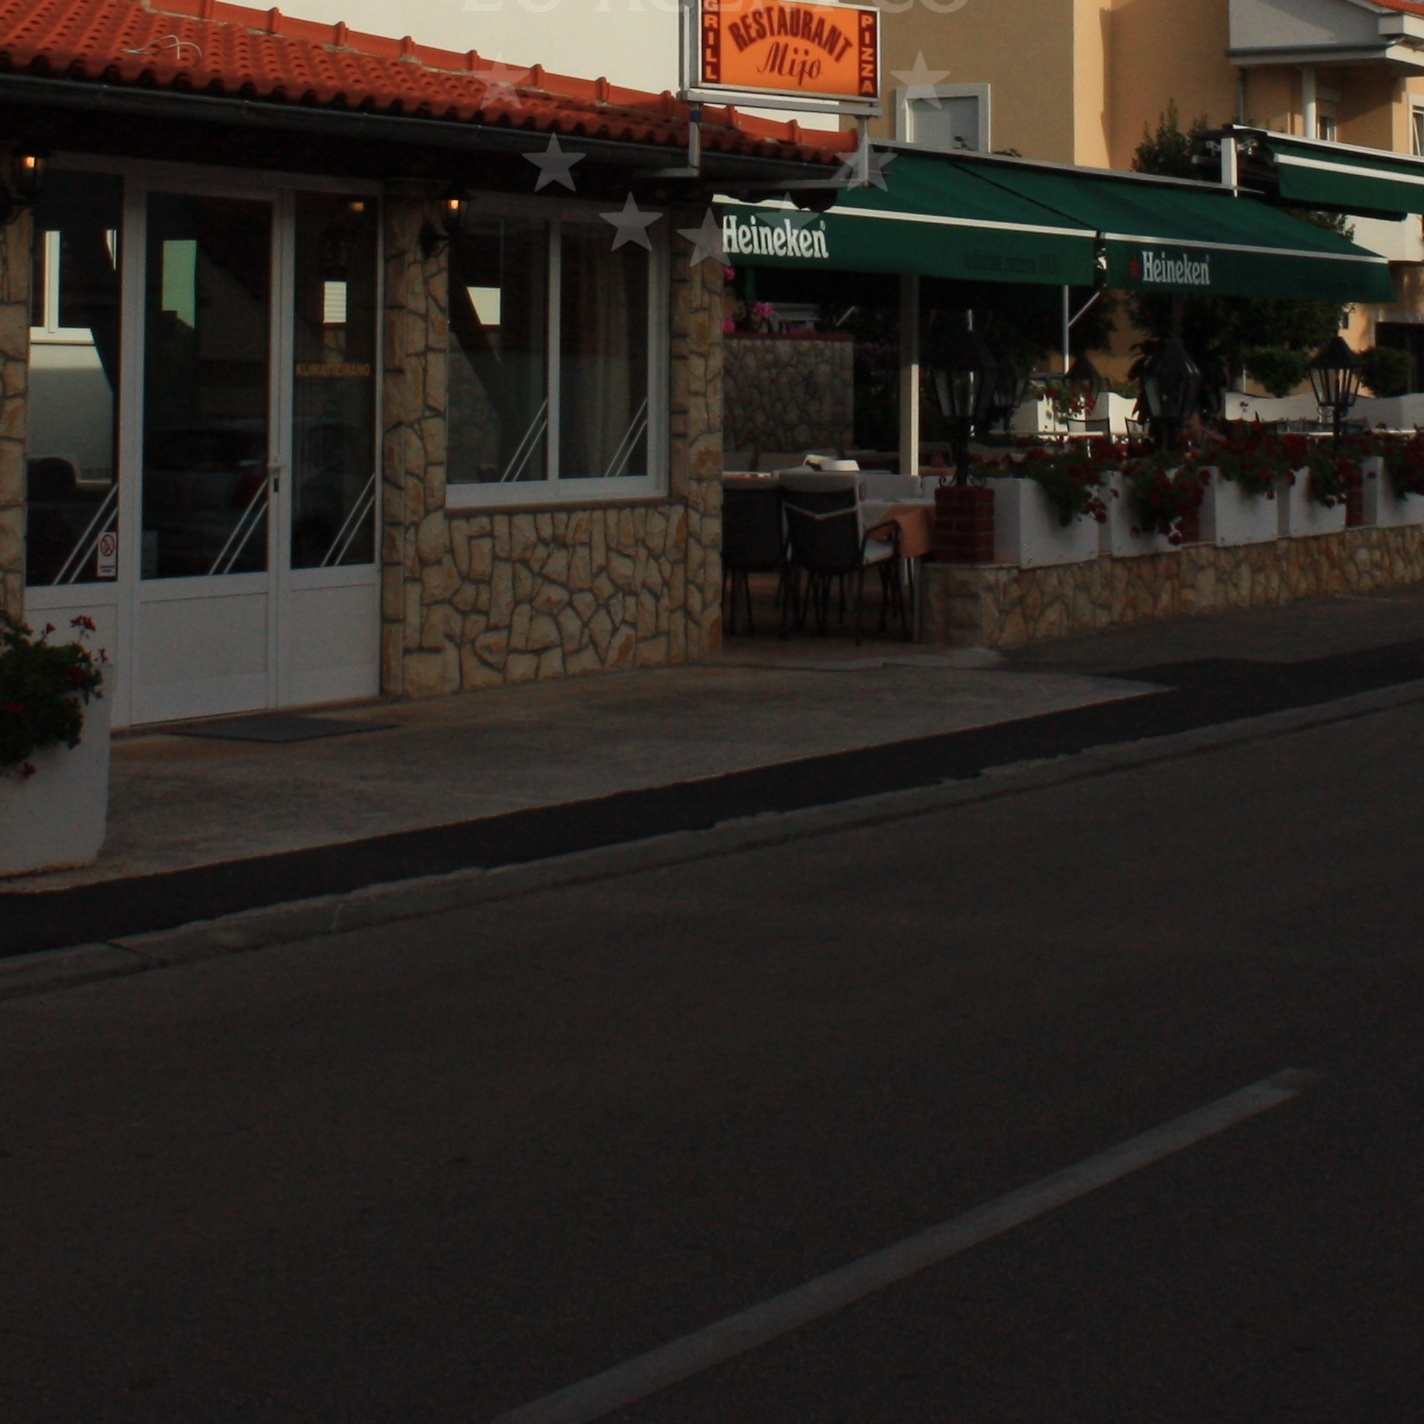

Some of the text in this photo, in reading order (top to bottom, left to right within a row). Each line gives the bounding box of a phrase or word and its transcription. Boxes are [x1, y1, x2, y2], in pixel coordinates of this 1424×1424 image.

[728, 5, 854, 64] RESTAURANT
[860, 14, 875, 94] PIZZA
[757, 40, 822, 87] Mijo
[722, 214, 829, 259] Heineken
[1141, 250, 1211, 285] Heineken
